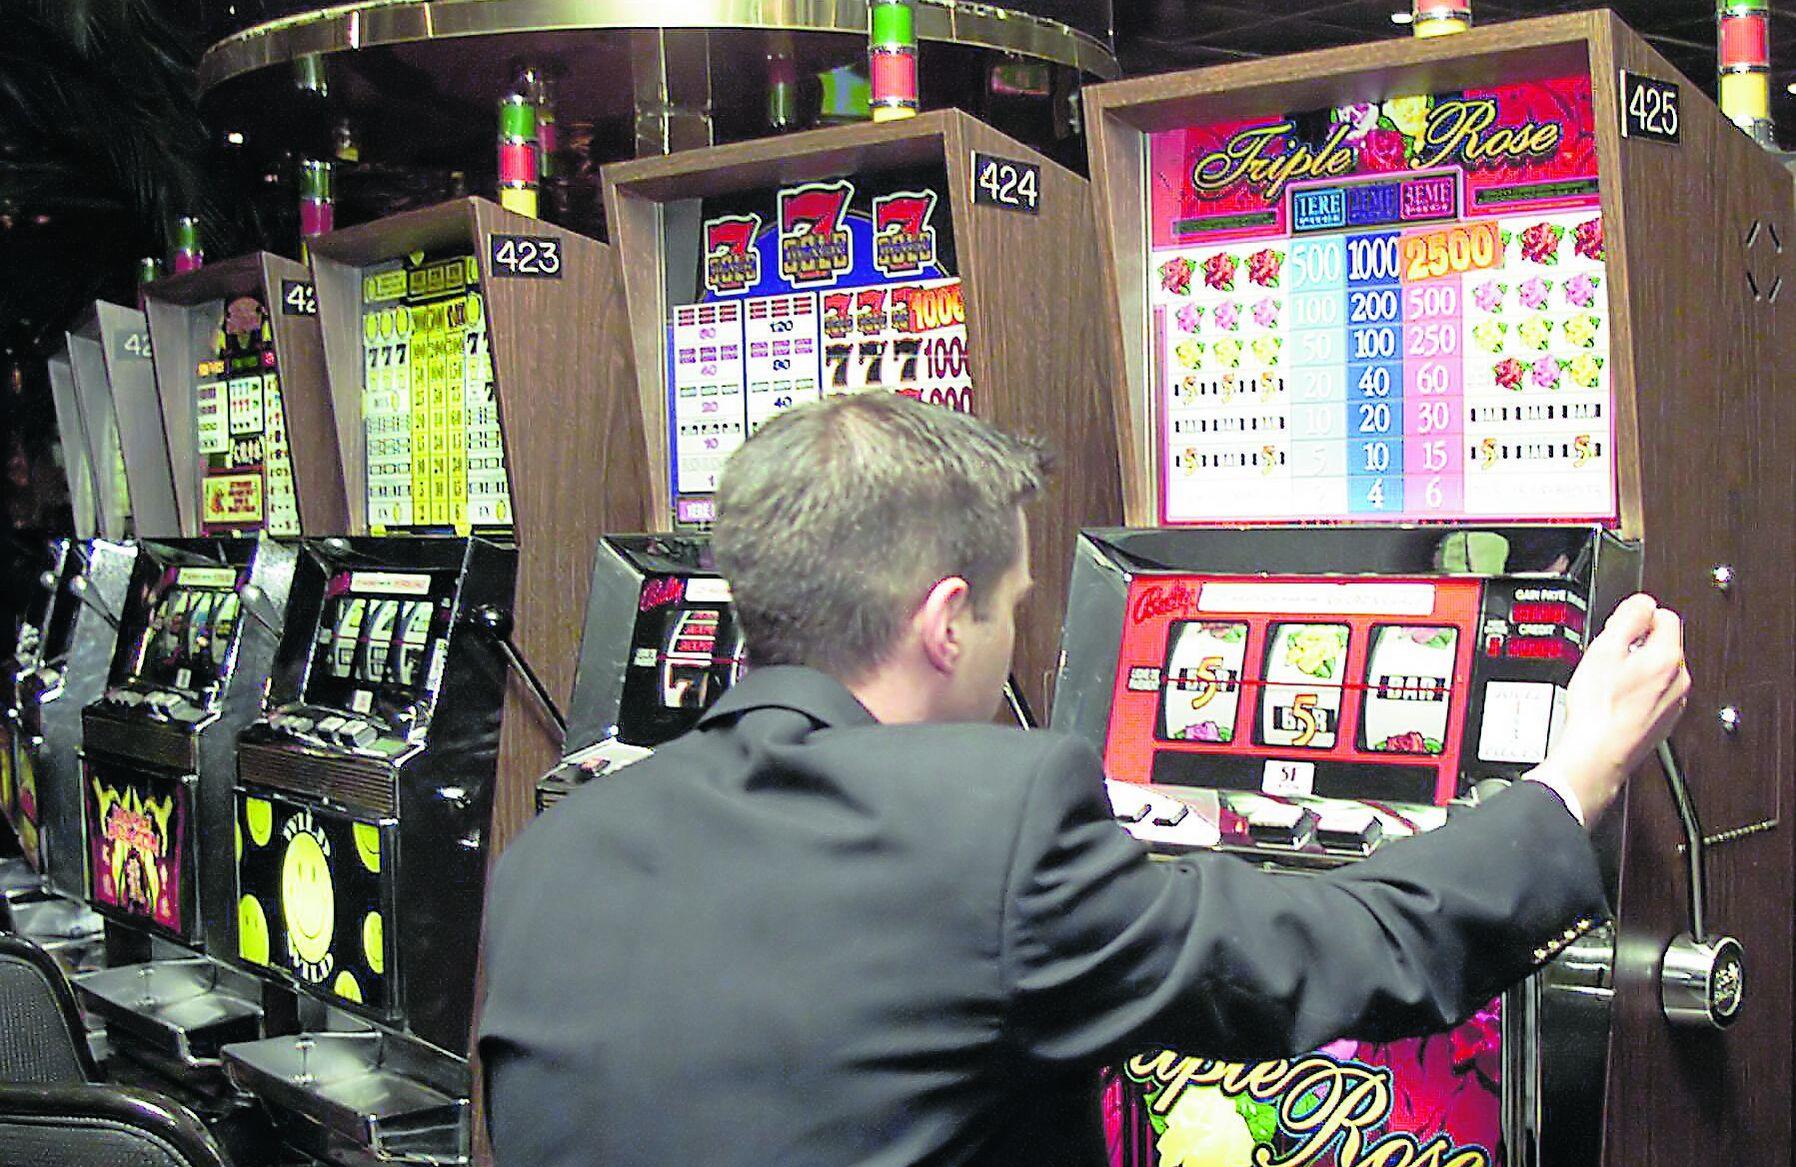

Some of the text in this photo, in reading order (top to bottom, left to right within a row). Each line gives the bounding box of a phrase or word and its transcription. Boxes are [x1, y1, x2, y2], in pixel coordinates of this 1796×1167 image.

[1629, 84, 1678, 136] 425
[1194, 99, 1562, 199] Triple Rose
[979, 162, 1038, 207] 424
[496, 240, 560, 274] 423
[1291, 243, 1341, 288] 500
[1347, 235, 1400, 282] 1000
[1405, 226, 1493, 282] 2500
[1350, 290, 1398, 323] 200
[1409, 286, 1457, 320] 500
[396, 343, 407, 364] 7
[924, 336, 972, 379] 100
[1354, 327, 1395, 359] 100
[1408, 323, 1457, 358] 250
[1358, 364, 1391, 397] 40
[1416, 361, 1450, 394] 60
[1358, 402, 1391, 433] 20
[1416, 400, 1450, 434] 30
[1361, 441, 1390, 472] 10
[1422, 439, 1448, 472] 15
[1366, 477, 1385, 510] 4
[1425, 476, 1444, 509] 6
[1191, 656, 1224, 710] 5
[1291, 693, 1318, 746] 5
